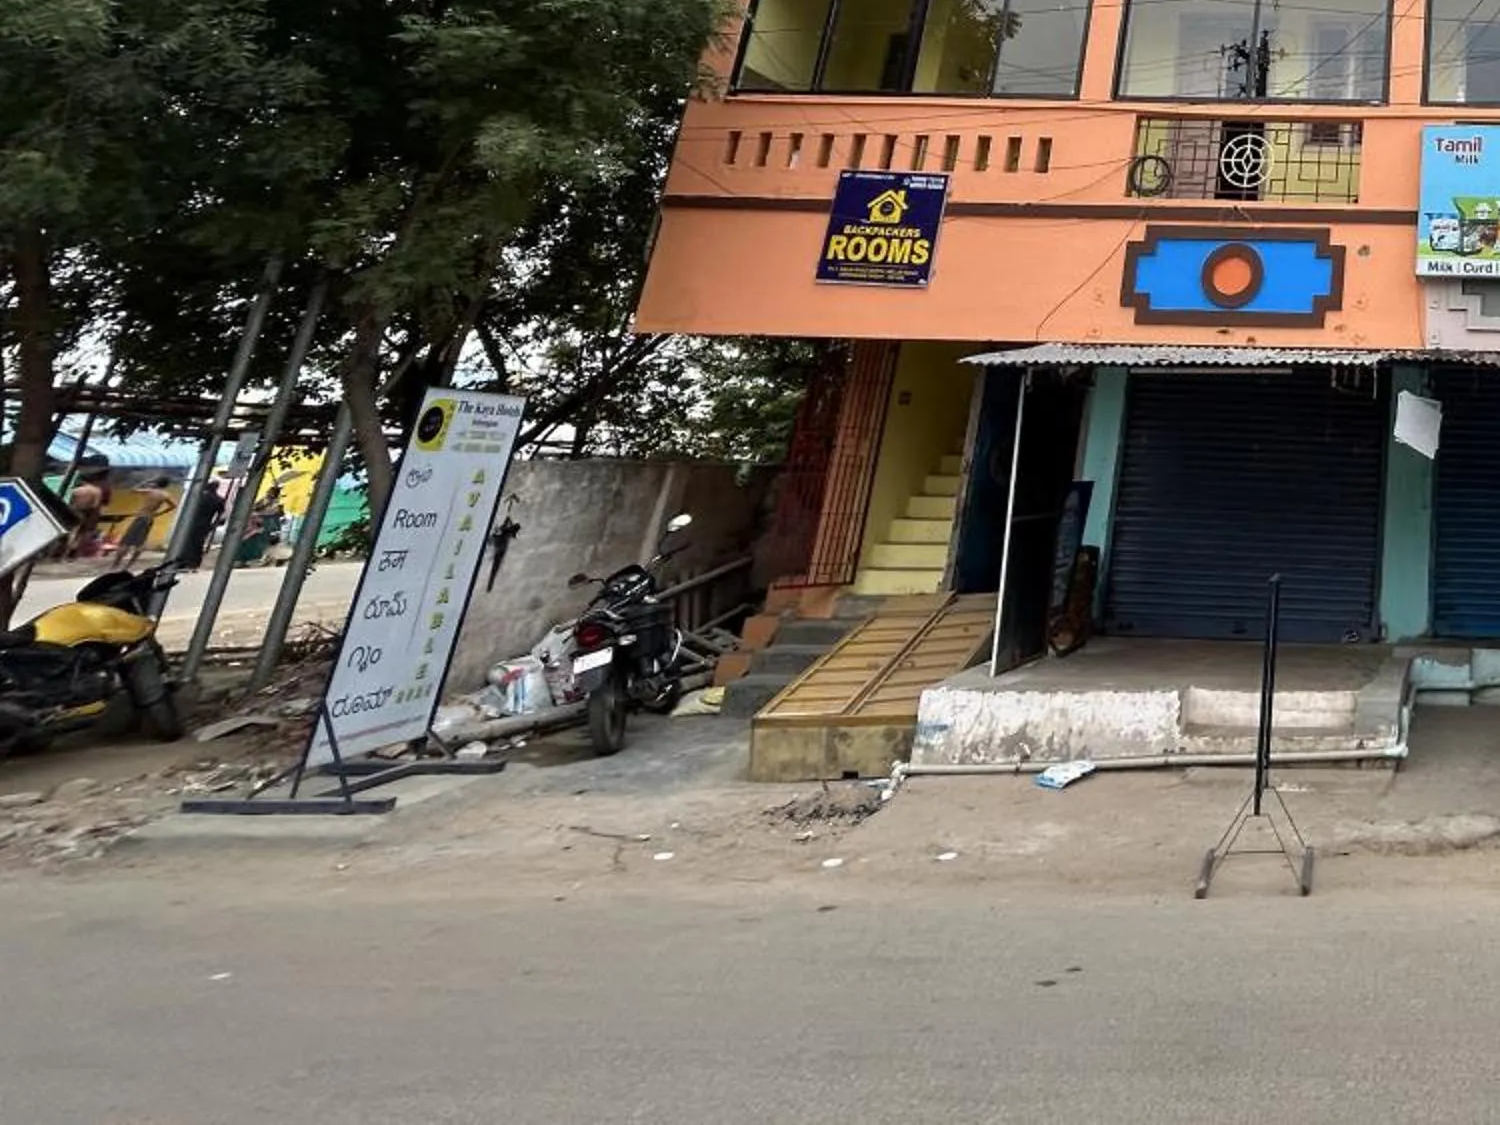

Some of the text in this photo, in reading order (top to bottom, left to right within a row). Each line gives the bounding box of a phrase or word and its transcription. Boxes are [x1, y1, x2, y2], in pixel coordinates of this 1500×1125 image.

[1435, 136, 1483, 153] Tamil
[1455, 153, 1479, 165] Milk
[843, 224, 921, 238] BACKPACKERS
[826, 234, 930, 265] ROOMS
[1427, 261, 1453, 273] Milk
[1463, 262, 1493, 274] Curd
[393, 508, 438, 528] Room
